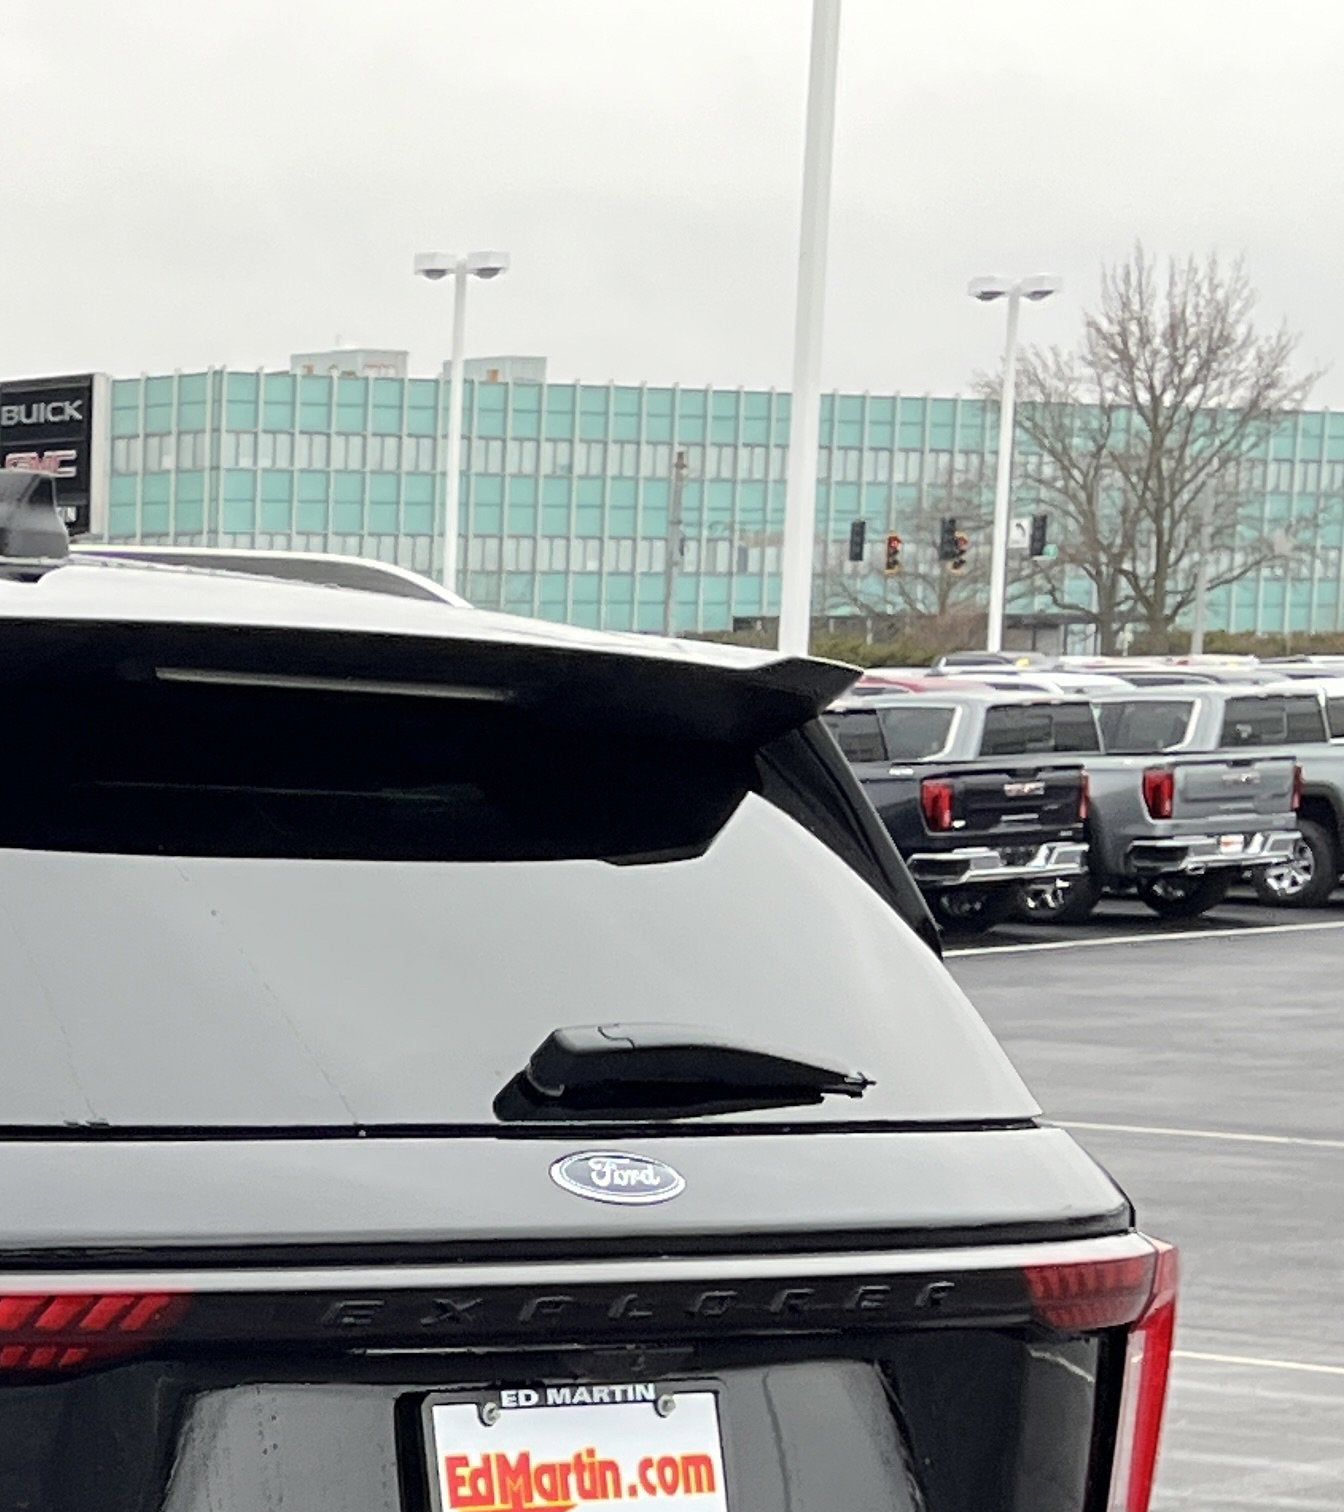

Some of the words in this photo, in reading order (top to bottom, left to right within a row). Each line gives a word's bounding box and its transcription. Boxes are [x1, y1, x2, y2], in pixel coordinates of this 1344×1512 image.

[0, 399, 83, 427] BUICK
[587, 1157, 661, 1187] Ford
[319, 1281, 957, 1329] EXPLORER
[499, 1388, 539, 1409] ED
[546, 1383, 656, 1406] MARTIN
[444, 1446, 716, 1509] EdMartin.com
